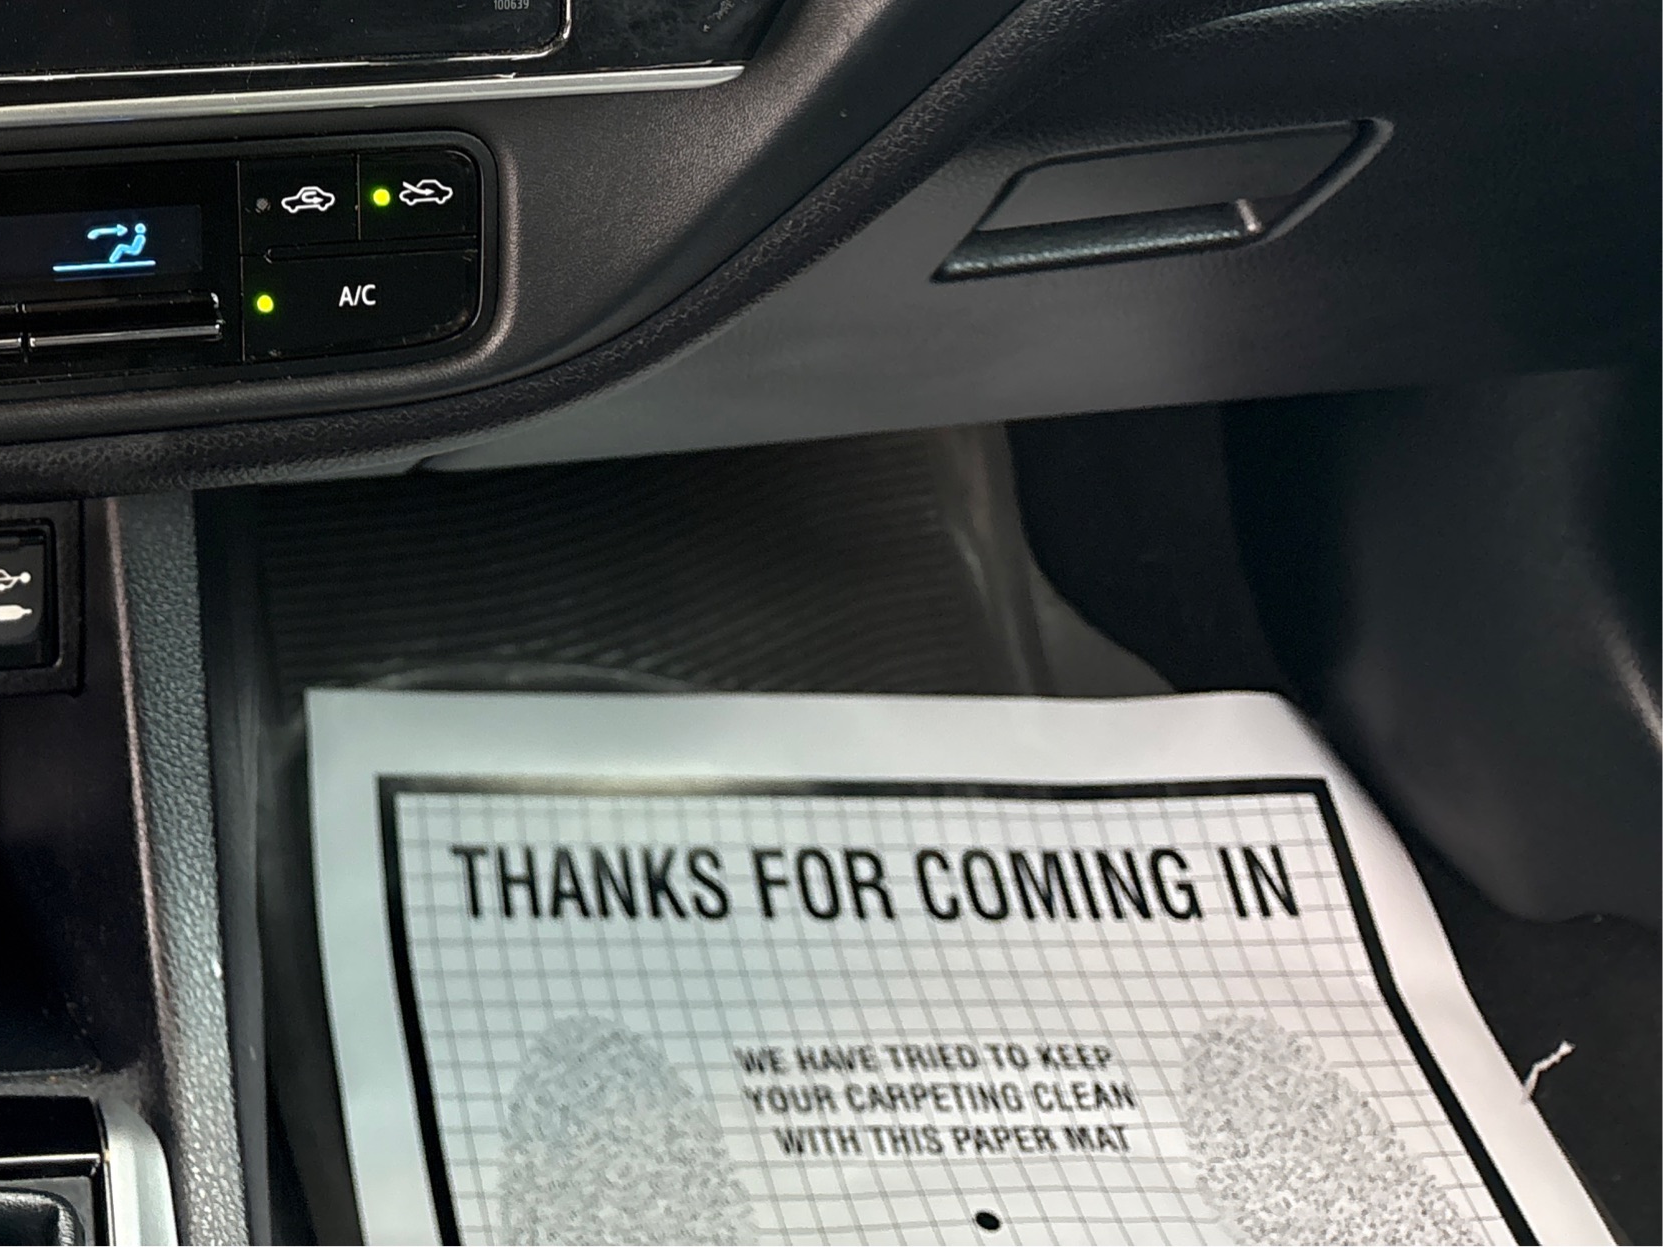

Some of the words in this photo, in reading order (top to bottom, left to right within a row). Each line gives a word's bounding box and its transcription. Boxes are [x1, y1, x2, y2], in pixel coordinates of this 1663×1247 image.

[337, 283, 377, 309] A/C
[451, 845, 732, 921] THANKS
[752, 847, 897, 921] FOR
[913, 847, 1204, 922] COMING
[1217, 845, 1300, 919] IN
[739, 1045, 786, 1074] WE
[796, 1046, 878, 1073] HAVE
[886, 1044, 979, 1072] TRIED
[985, 1043, 1033, 1070] TO
[1038, 1043, 1113, 1071] KEEP
[744, 1084, 839, 1113] YOUR
[844, 1082, 1025, 1113] CARPETING
[1034, 1080, 1136, 1112] CLEAN
[775, 1126, 863, 1154] WITH
[870, 1125, 946, 1153] THIS
[951, 1125, 1054, 1153] PAPER
[1063, 1124, 1133, 1153] MAT
